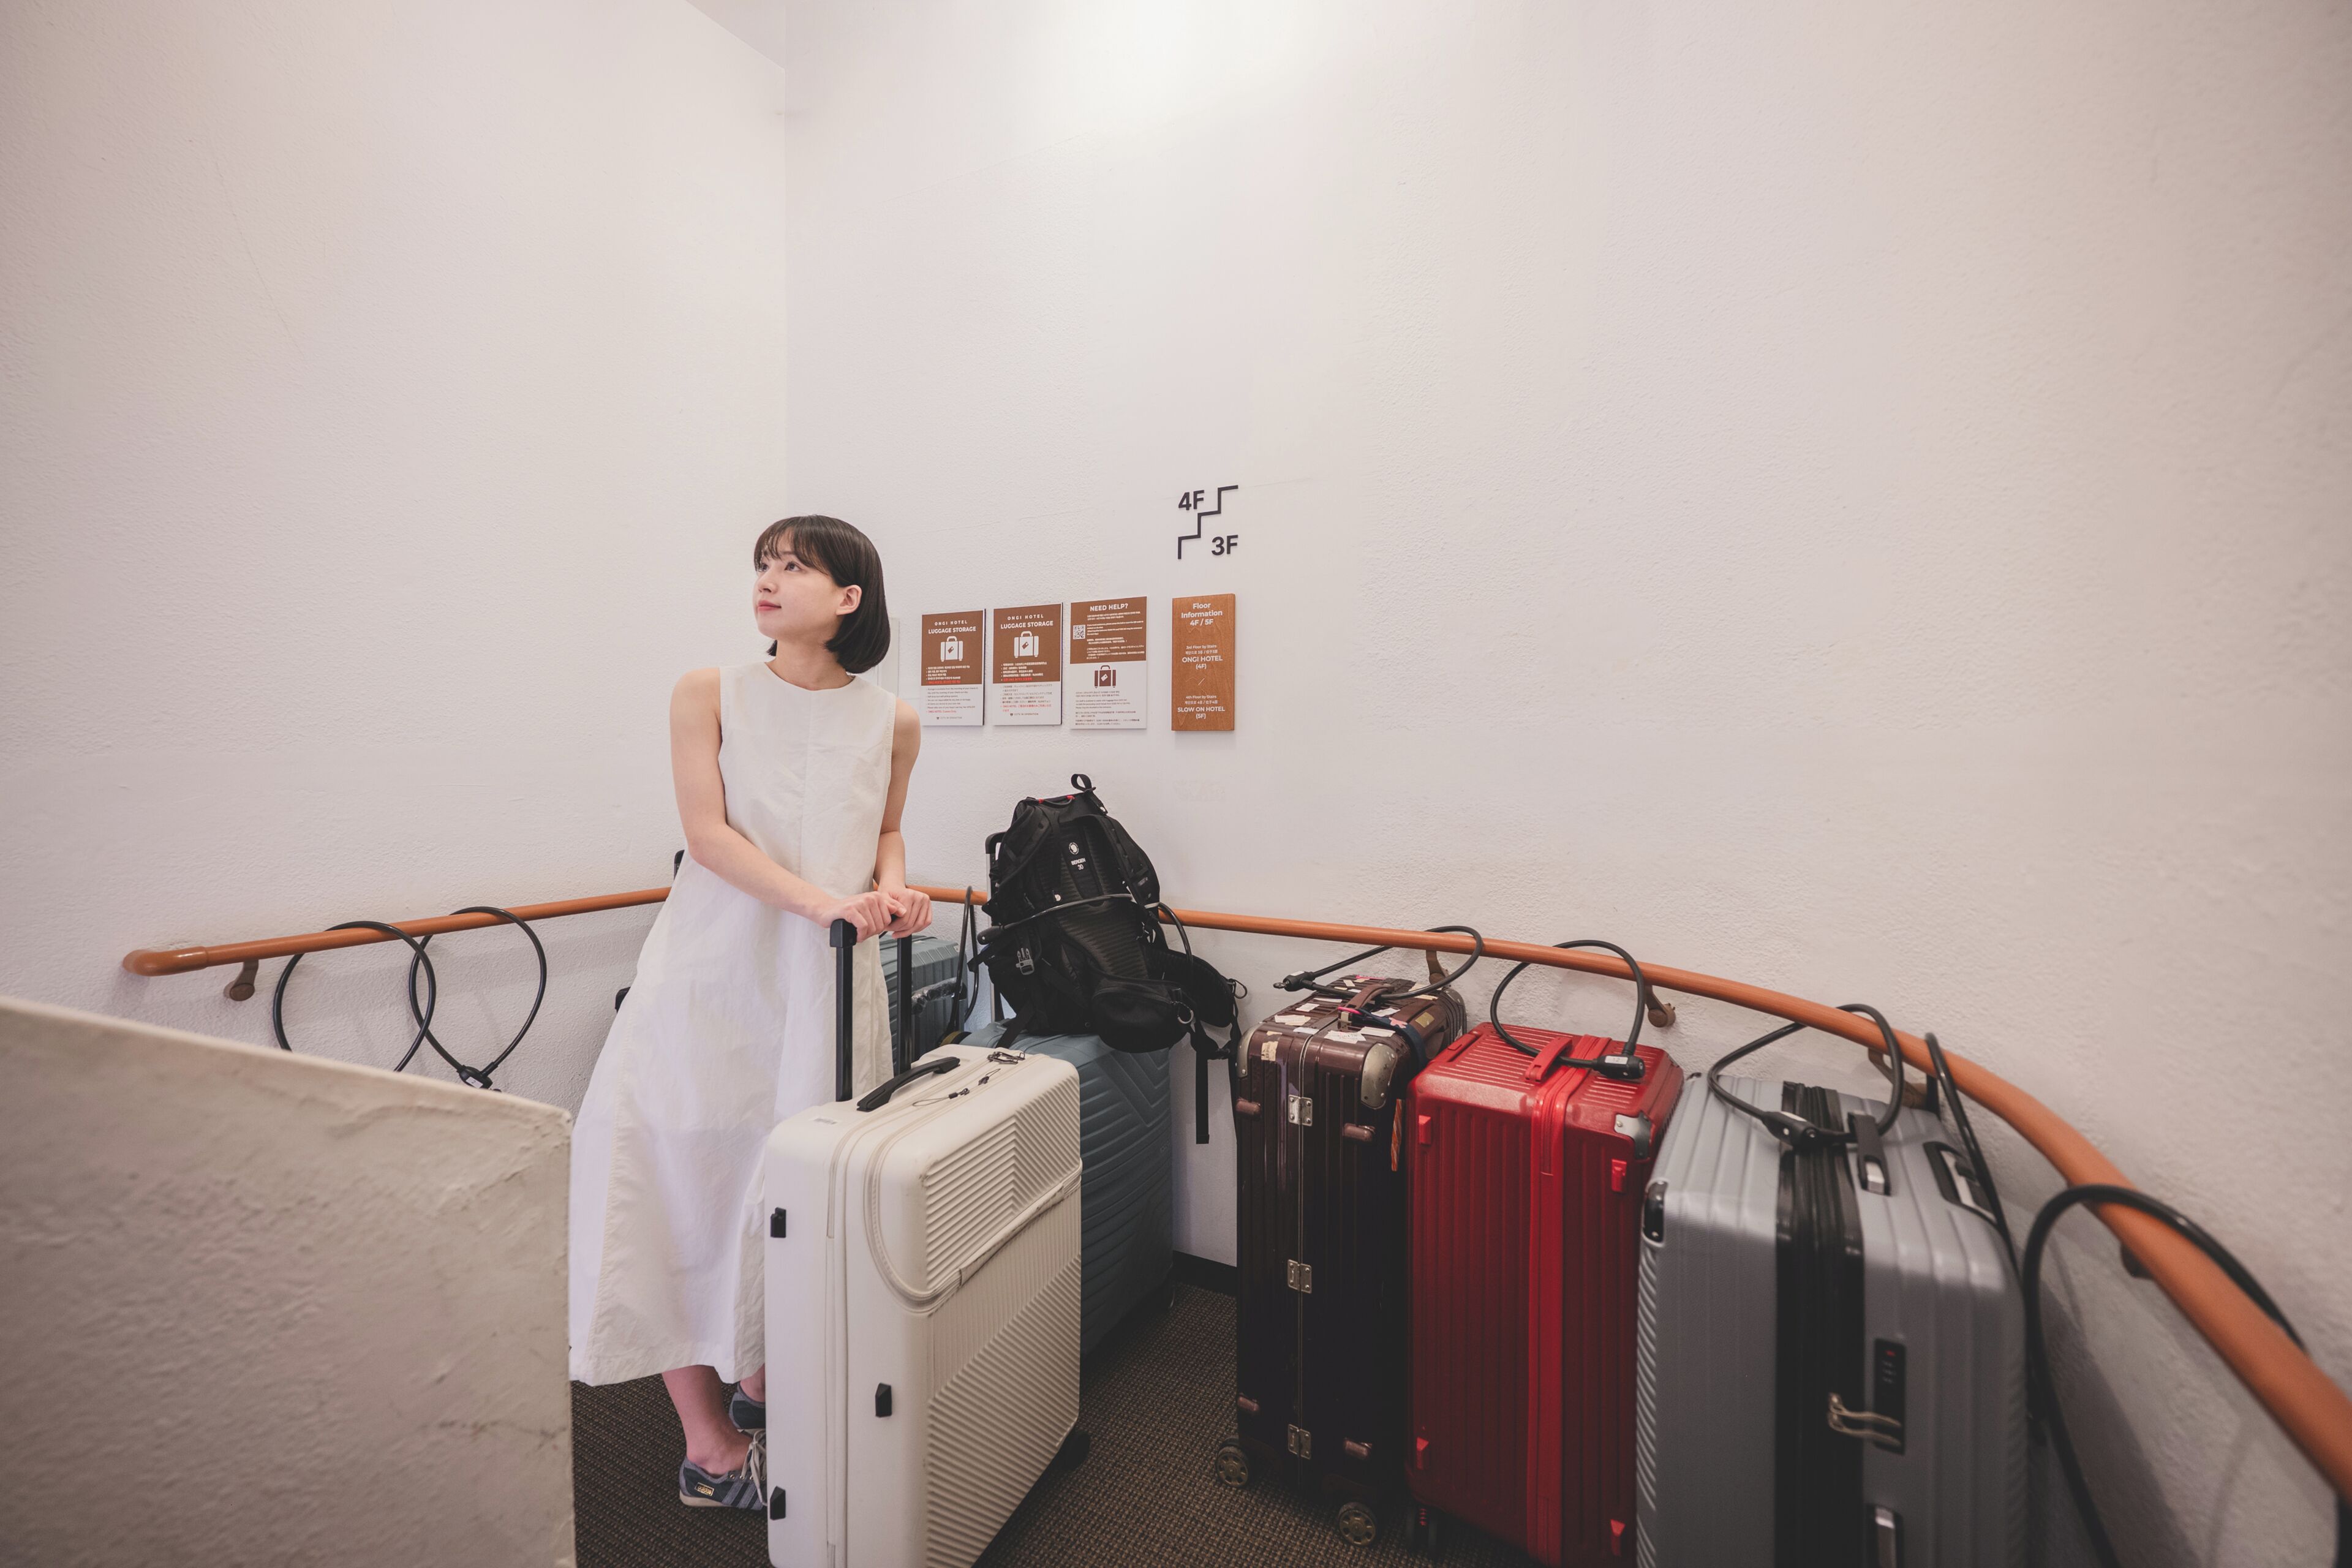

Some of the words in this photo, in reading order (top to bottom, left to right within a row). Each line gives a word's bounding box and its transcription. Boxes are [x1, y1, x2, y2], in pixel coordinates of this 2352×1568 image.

[1178, 489, 1205, 511] 4F
[1211, 534, 1238, 556] 3F
[1181, 610, 1223, 619] Information
